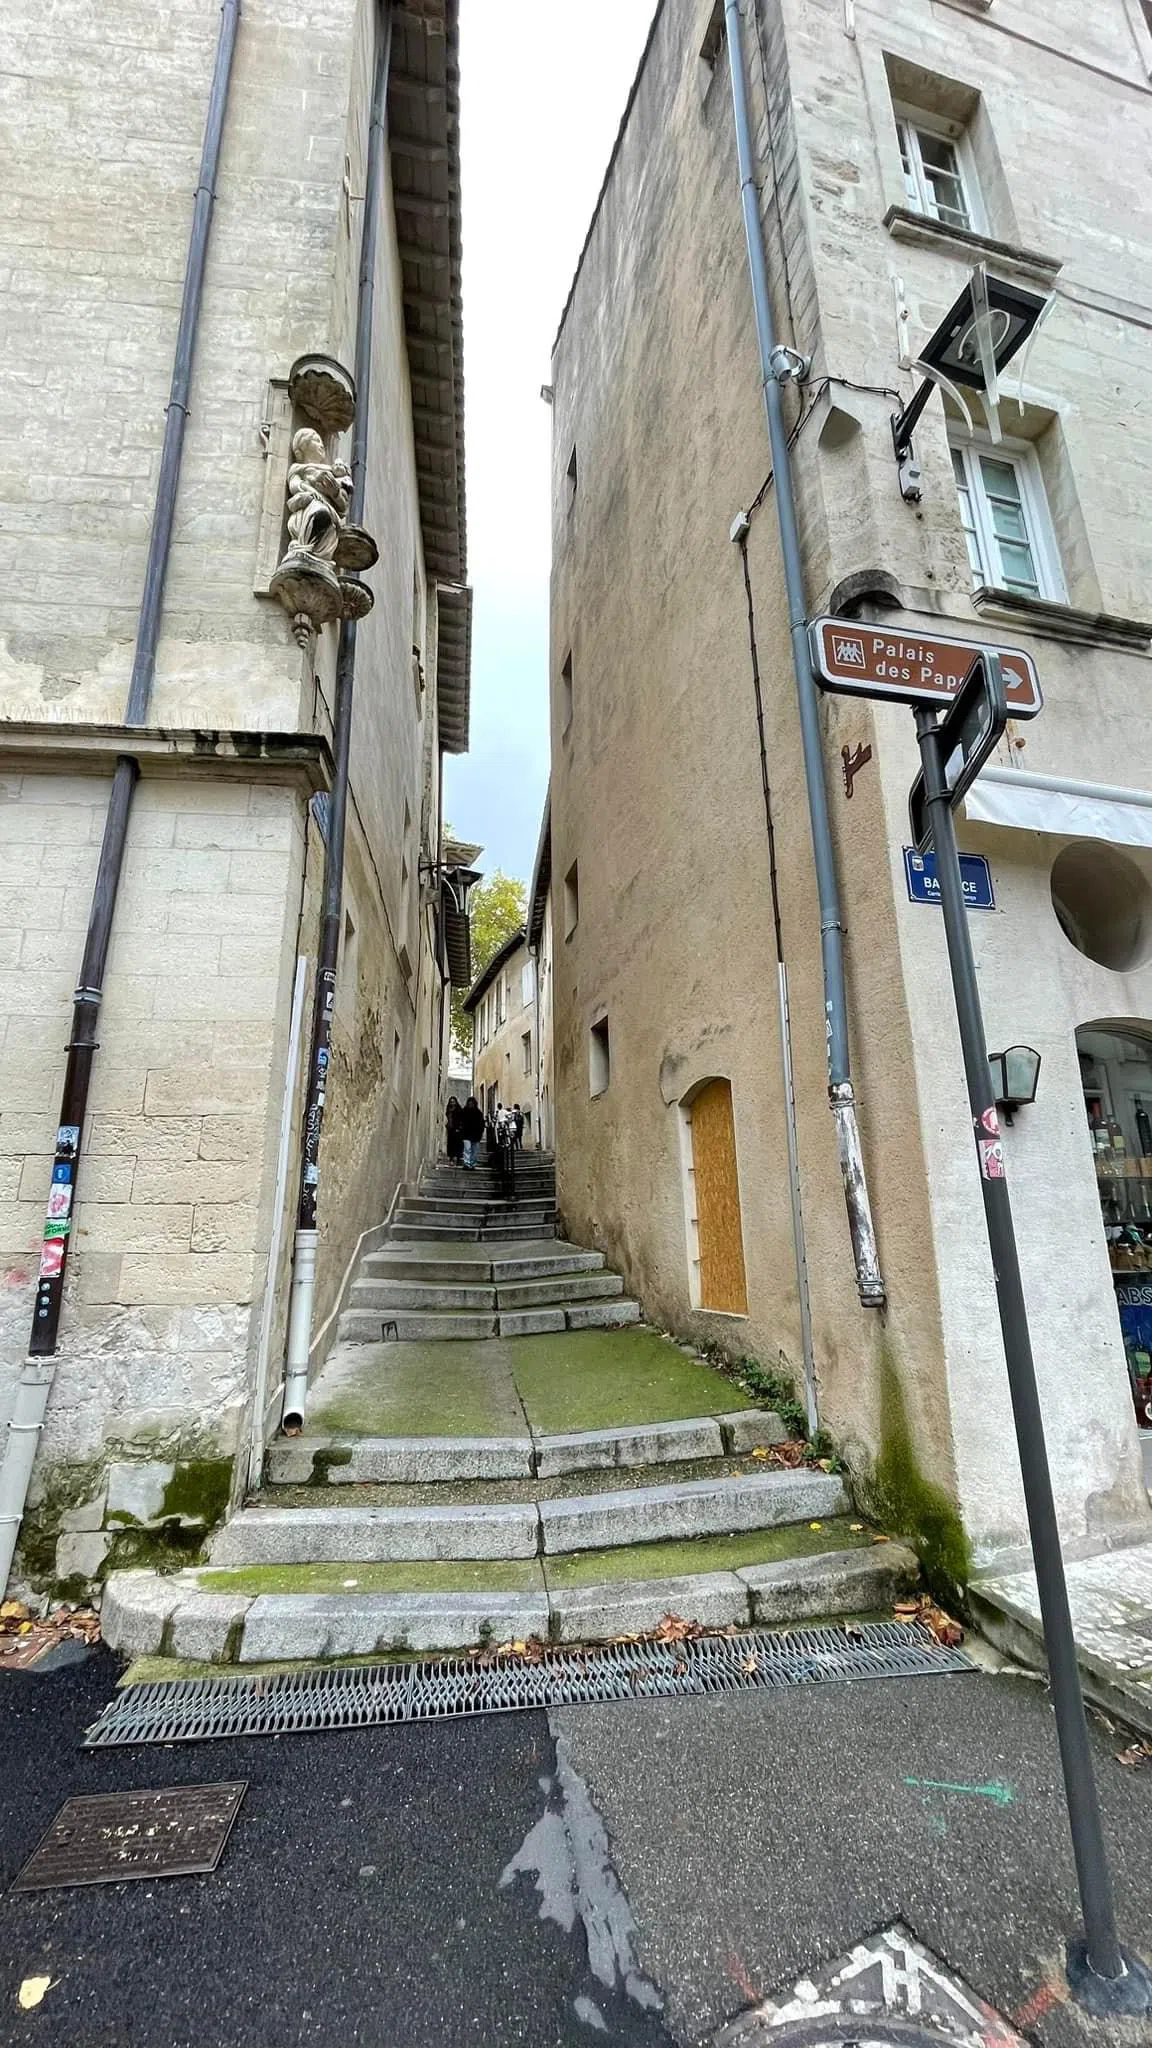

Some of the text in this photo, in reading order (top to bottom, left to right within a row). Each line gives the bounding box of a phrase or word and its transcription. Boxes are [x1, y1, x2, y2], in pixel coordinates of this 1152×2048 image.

[872, 638, 935, 664] Palais
[875, 660, 965, 690] des Pap
[923, 876, 977, 893] BACE
